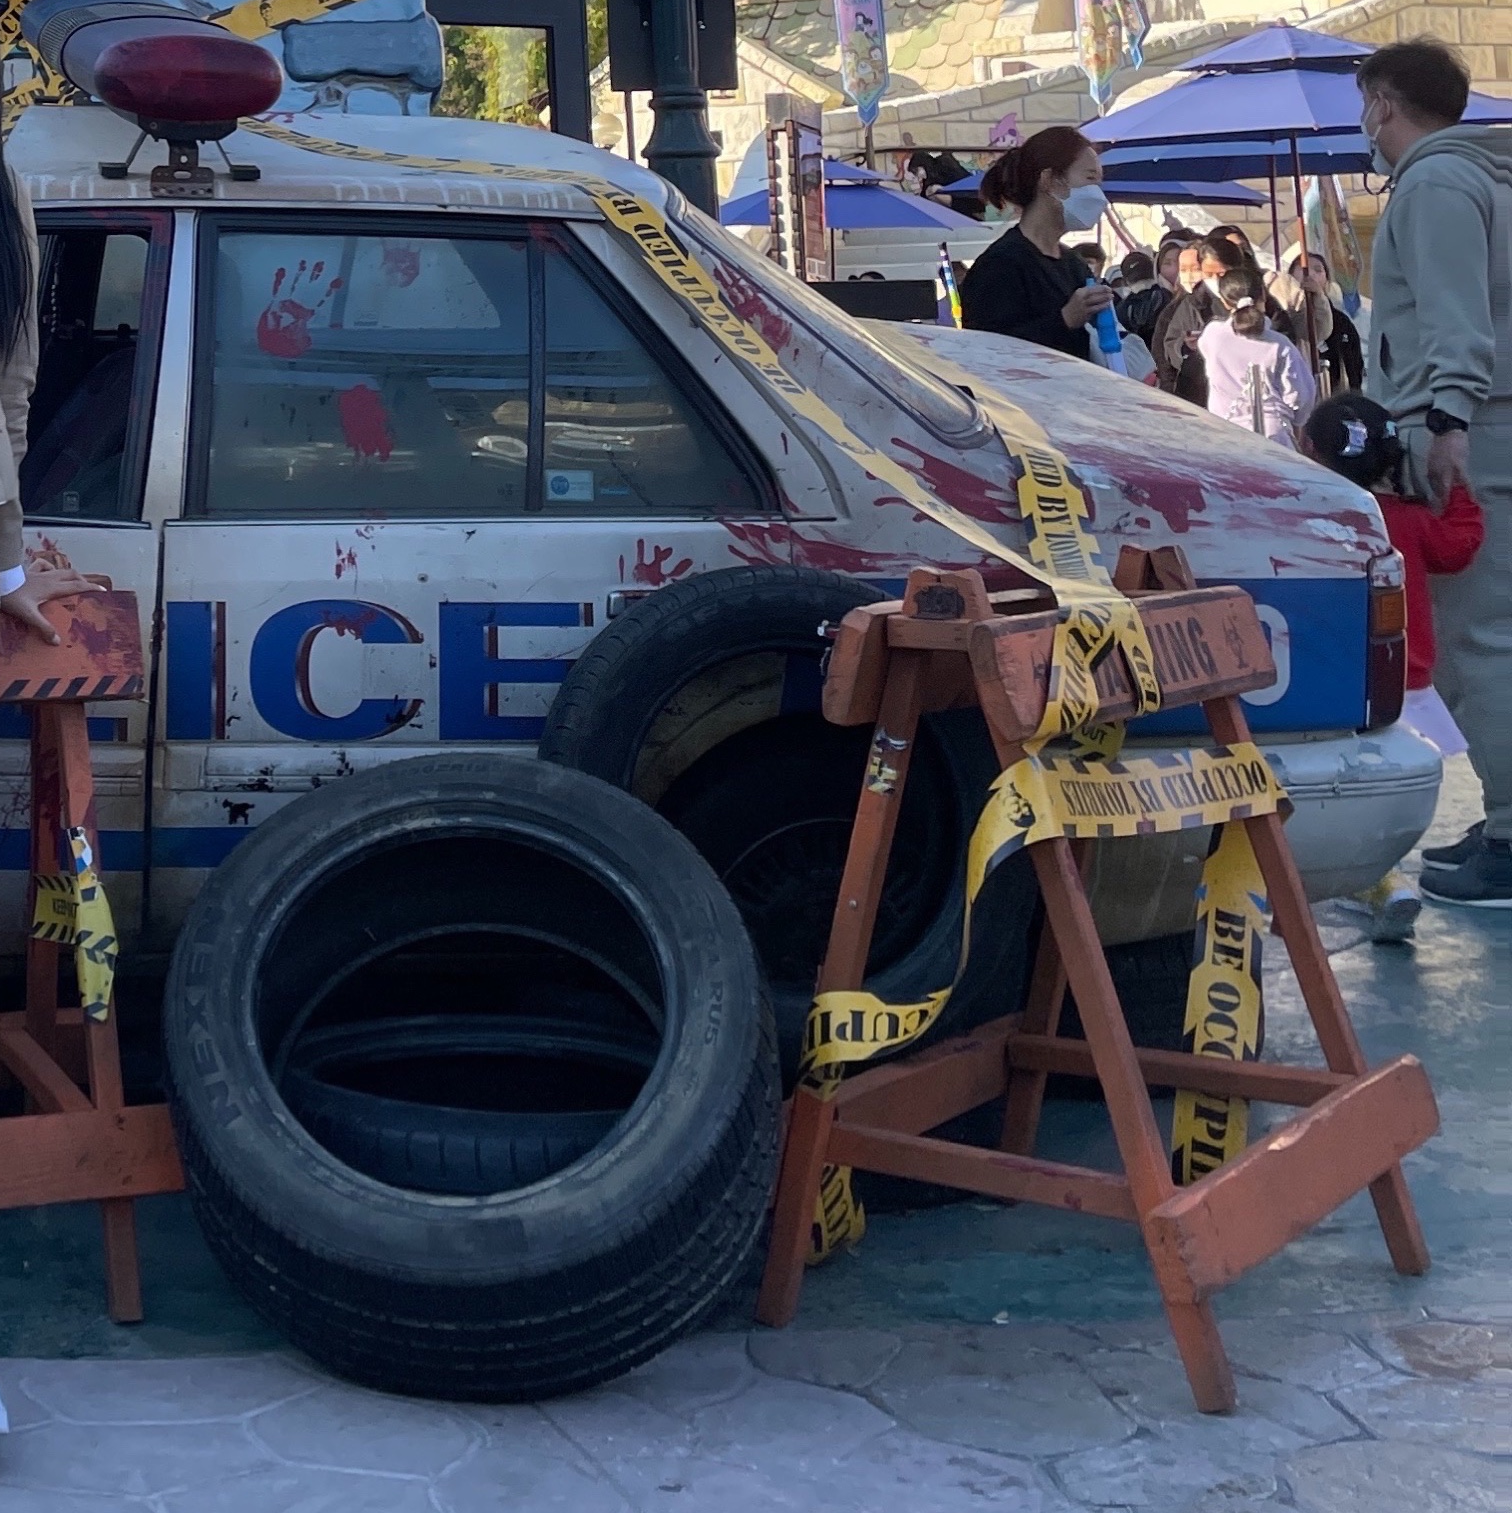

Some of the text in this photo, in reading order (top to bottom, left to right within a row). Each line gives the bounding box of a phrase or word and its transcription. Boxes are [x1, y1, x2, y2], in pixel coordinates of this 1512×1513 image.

[633, 222, 762, 356] OCCUPIED
[1037, 493, 1073, 526] BY
[1136, 778, 1165, 813] BY
[1161, 759, 1269, 810] OCCUPIED
[1210, 907, 1247, 972] BE
